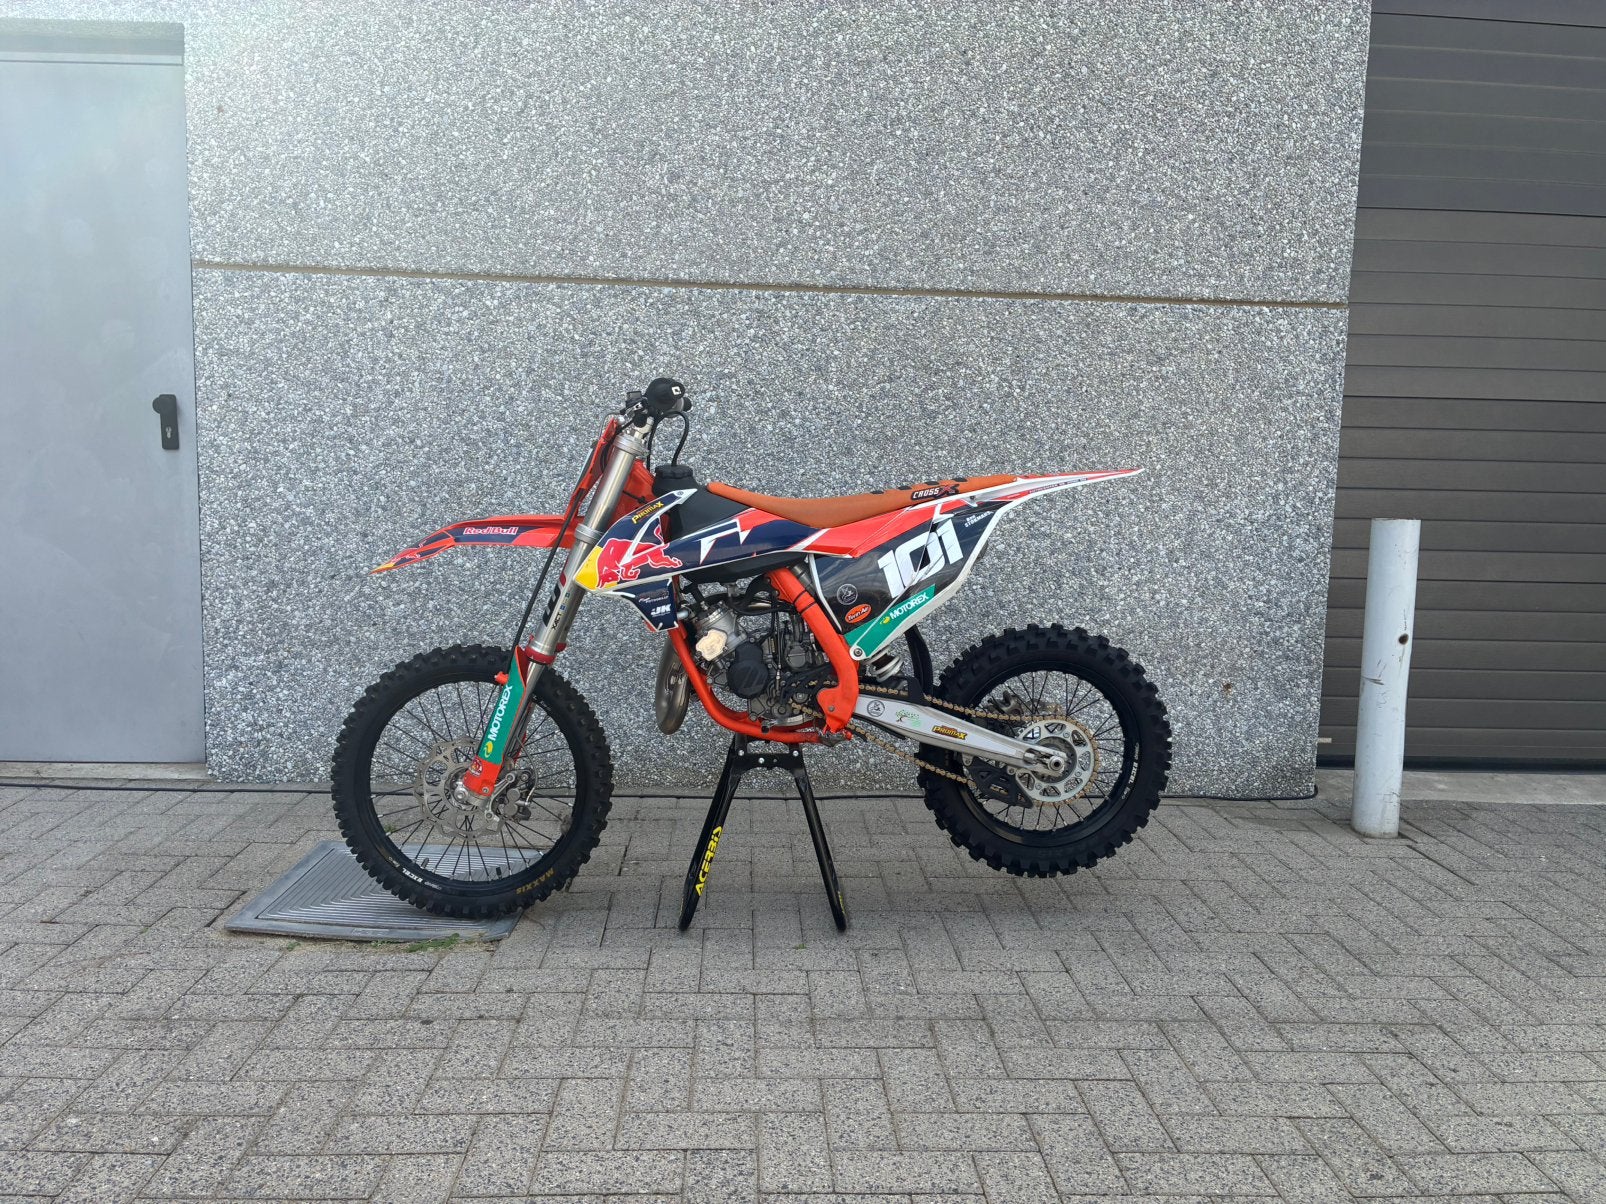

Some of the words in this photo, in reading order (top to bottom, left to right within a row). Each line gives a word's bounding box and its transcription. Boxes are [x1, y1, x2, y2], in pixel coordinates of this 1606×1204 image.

[878, 518, 963, 598] 101
[889, 592, 929, 620] MOTOREX
[488, 684, 512, 742] MOTOREX
